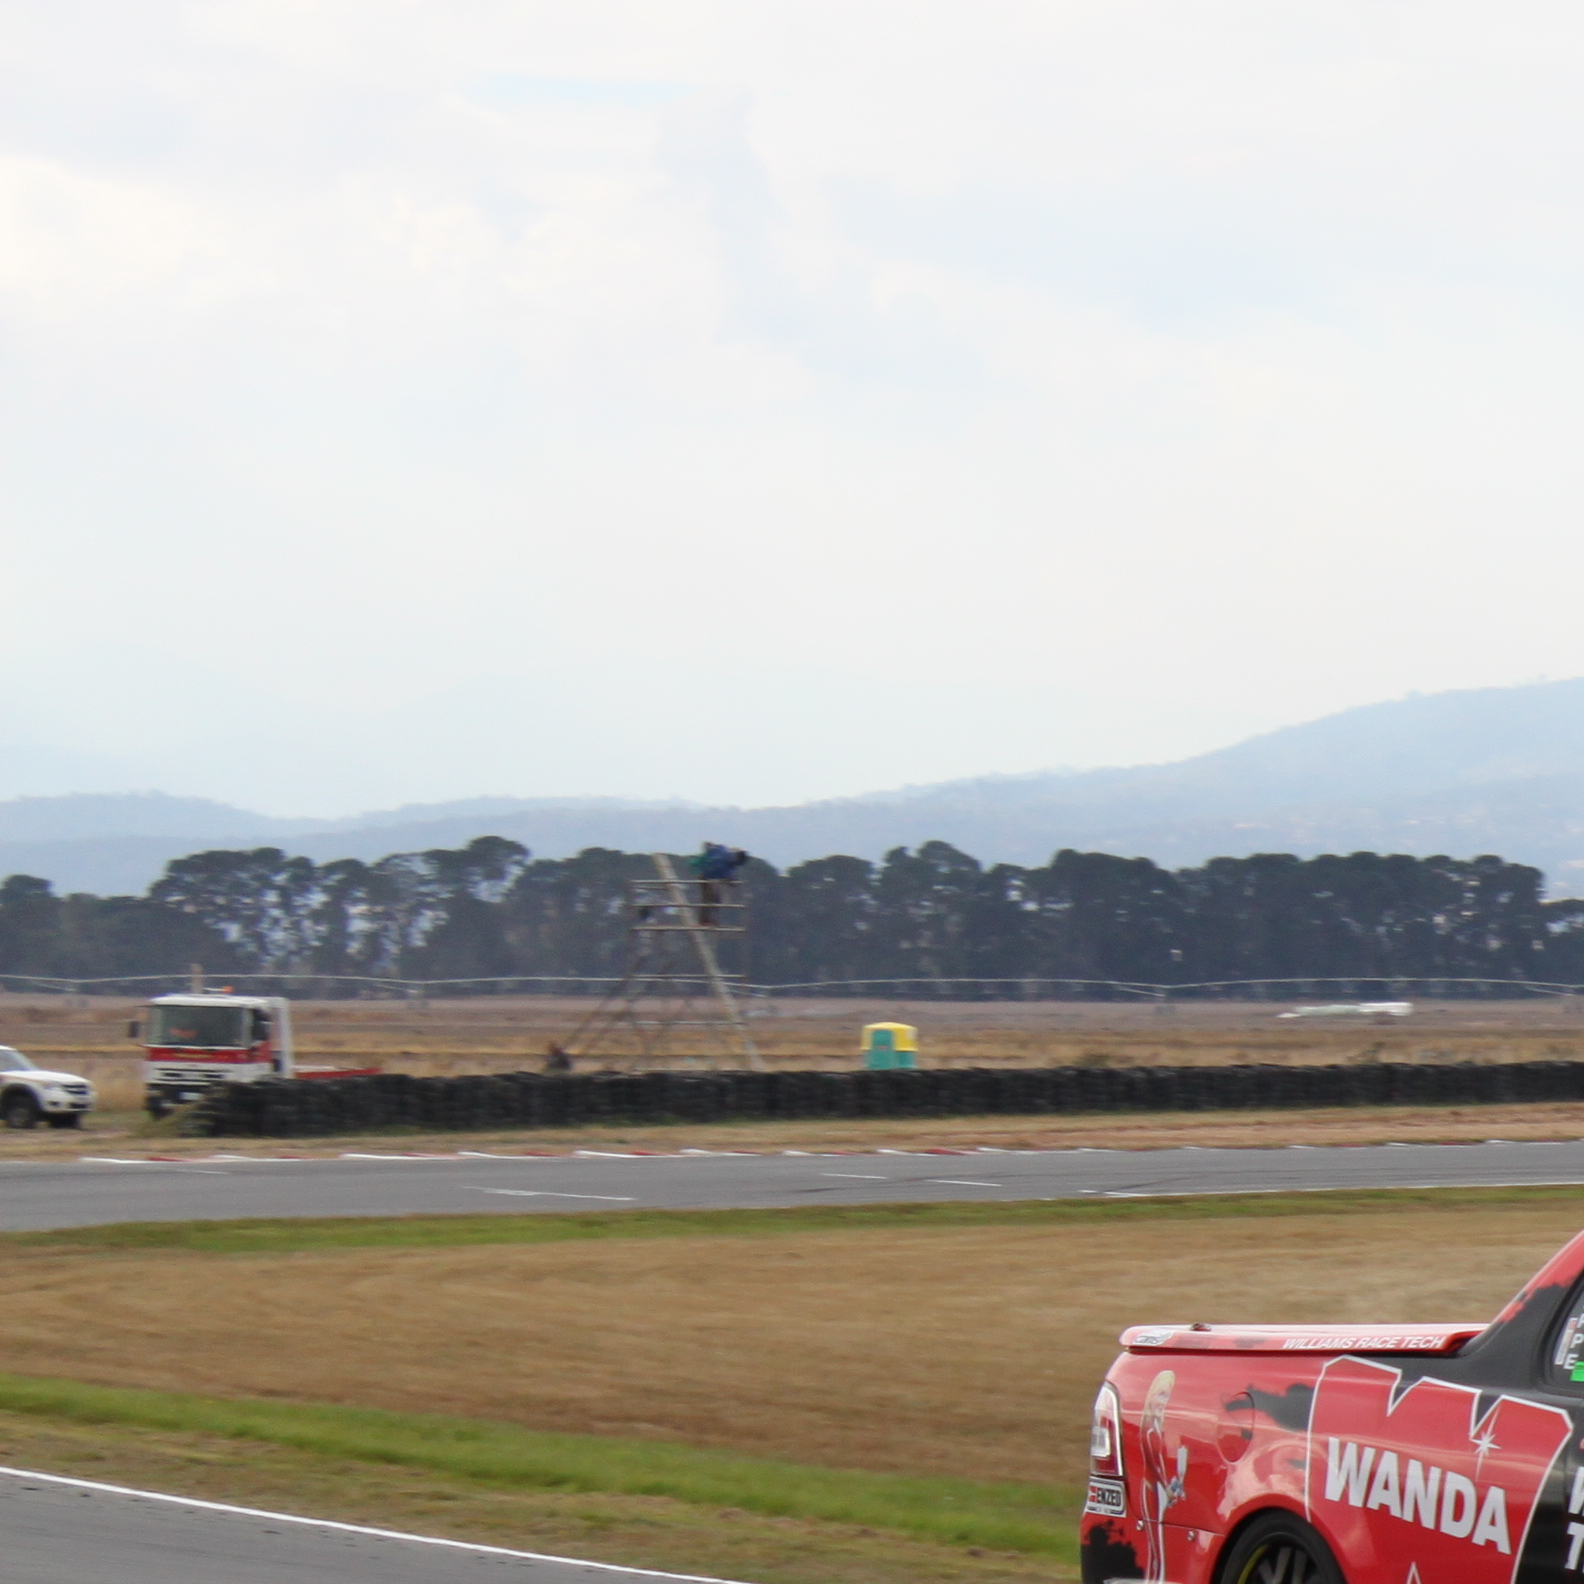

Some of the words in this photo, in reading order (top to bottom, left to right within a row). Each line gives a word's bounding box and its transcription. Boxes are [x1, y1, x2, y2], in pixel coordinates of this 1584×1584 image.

[1282, 1336, 1353, 1350] WILLIAMS
[1355, 1336, 1397, 1349] RACE
[1400, 1335, 1448, 1349] TECH
[1324, 1436, 1512, 1556] WANDA
